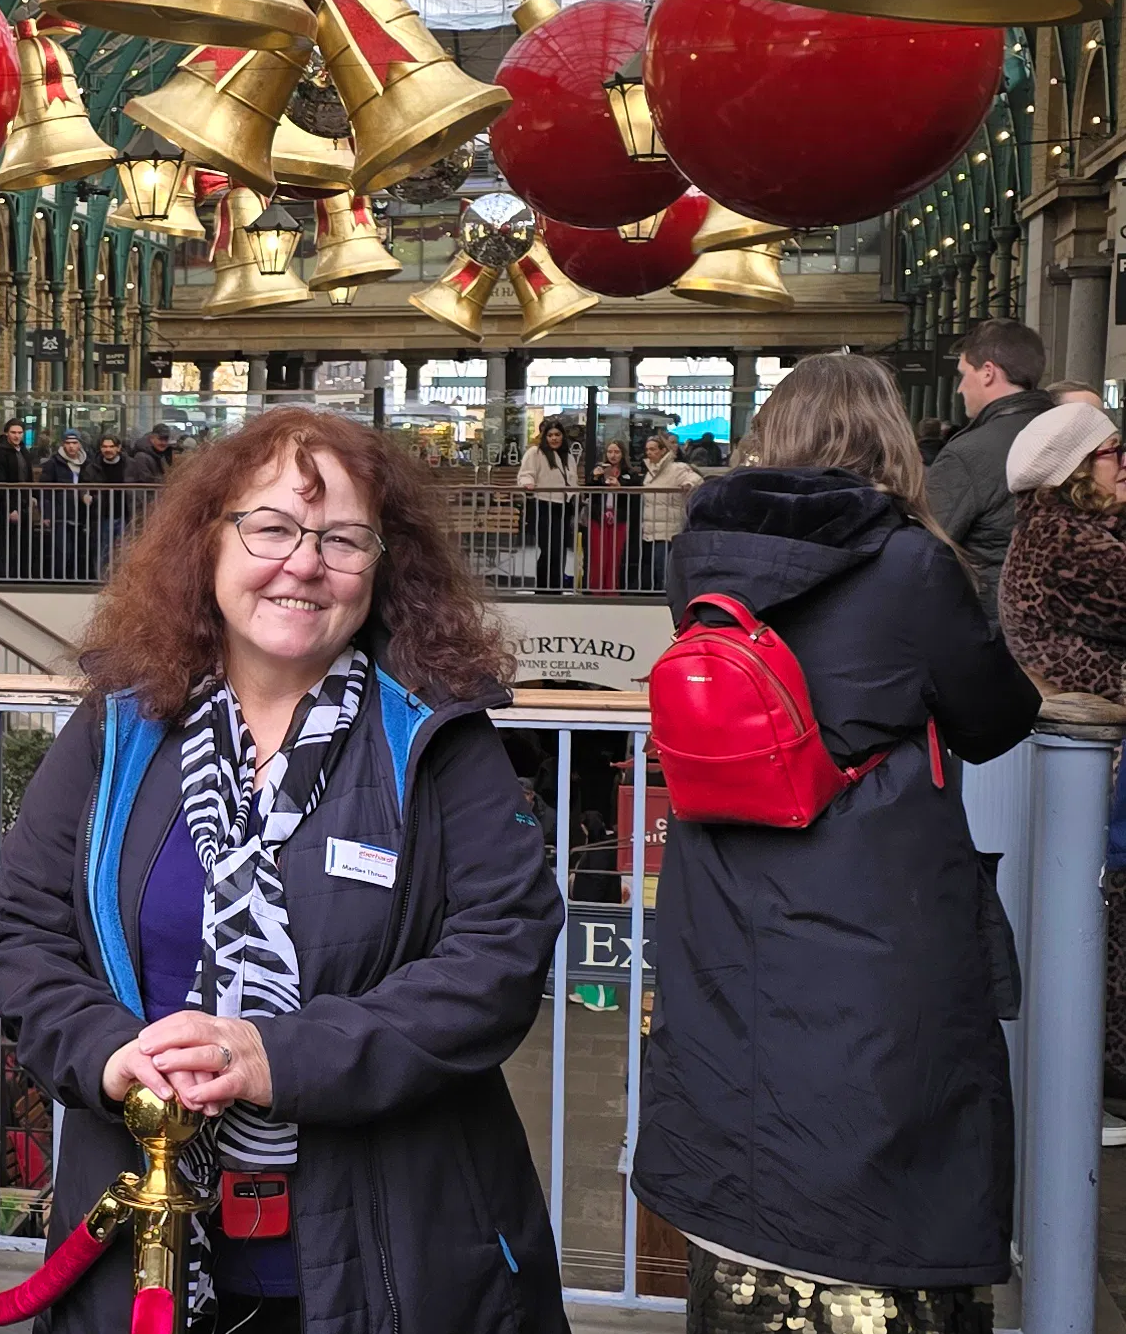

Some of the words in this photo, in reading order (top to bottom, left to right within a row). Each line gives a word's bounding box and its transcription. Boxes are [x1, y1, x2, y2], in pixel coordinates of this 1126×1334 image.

[502, 636, 636, 662] OURTYARD
[518, 659, 548, 669] WINE
[549, 660, 600, 671] CELLARS
